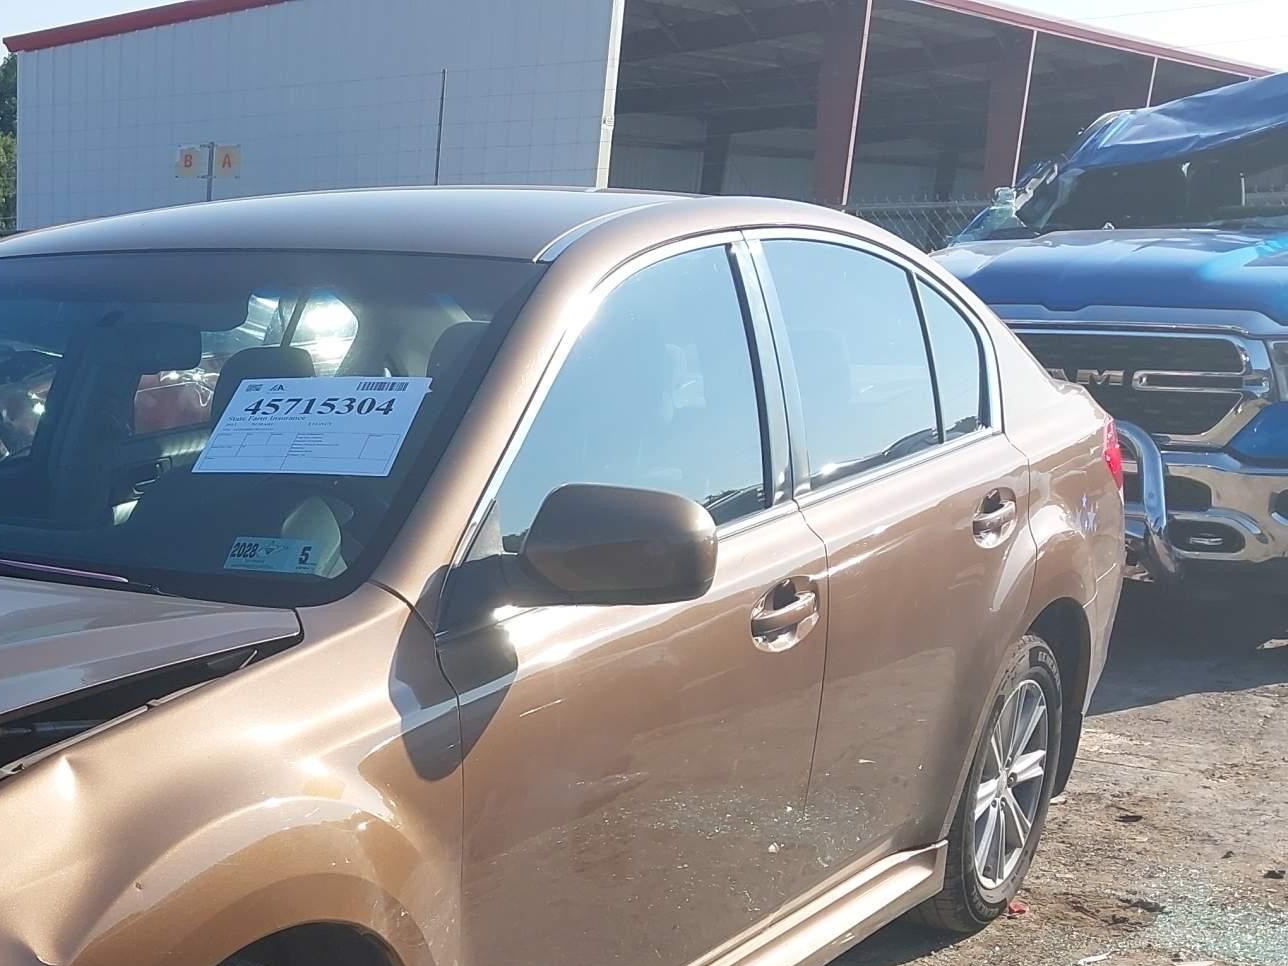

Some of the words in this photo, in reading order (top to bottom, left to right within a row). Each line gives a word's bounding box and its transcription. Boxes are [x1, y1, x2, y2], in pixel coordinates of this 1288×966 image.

[184, 154, 193, 168] B
[222, 154, 231, 168] A
[244, 397, 396, 415] 45715304
[230, 542, 259, 558] 2028
[298, 546, 312, 565] 5
